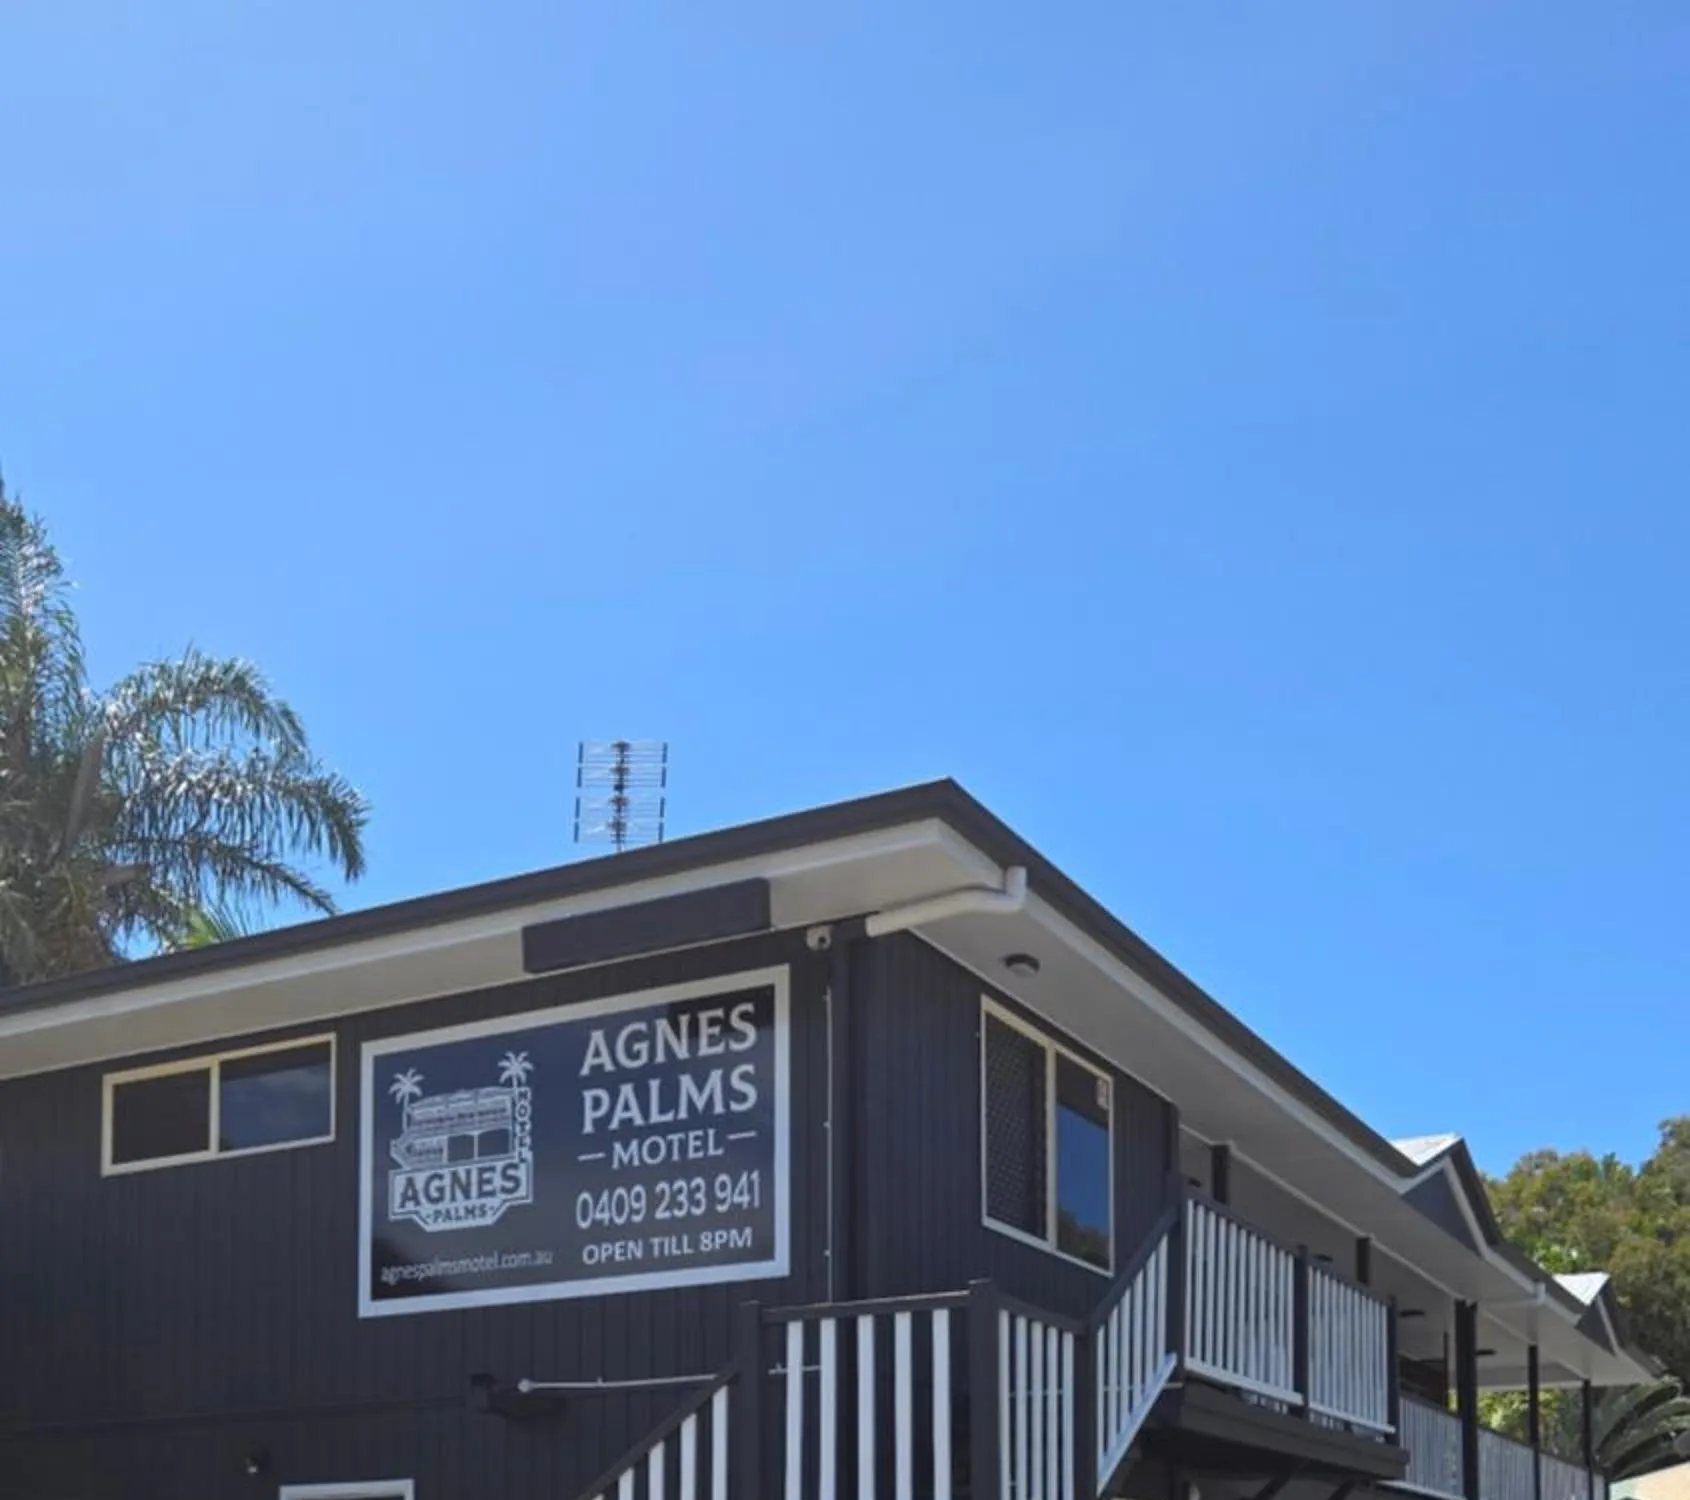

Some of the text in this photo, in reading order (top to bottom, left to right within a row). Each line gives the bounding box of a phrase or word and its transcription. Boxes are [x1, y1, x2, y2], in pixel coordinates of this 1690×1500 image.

[579, 1002, 757, 1076] AGNES
[582, 1063, 758, 1134] PALMS
[612, 1128, 725, 1170] MOTEL
[400, 1162, 521, 1208] AGNES
[576, 1170, 760, 1229] 0409 233 941
[432, 1203, 488, 1224] PALMS
[582, 1226, 753, 1265] OPEN TILL 8PM
